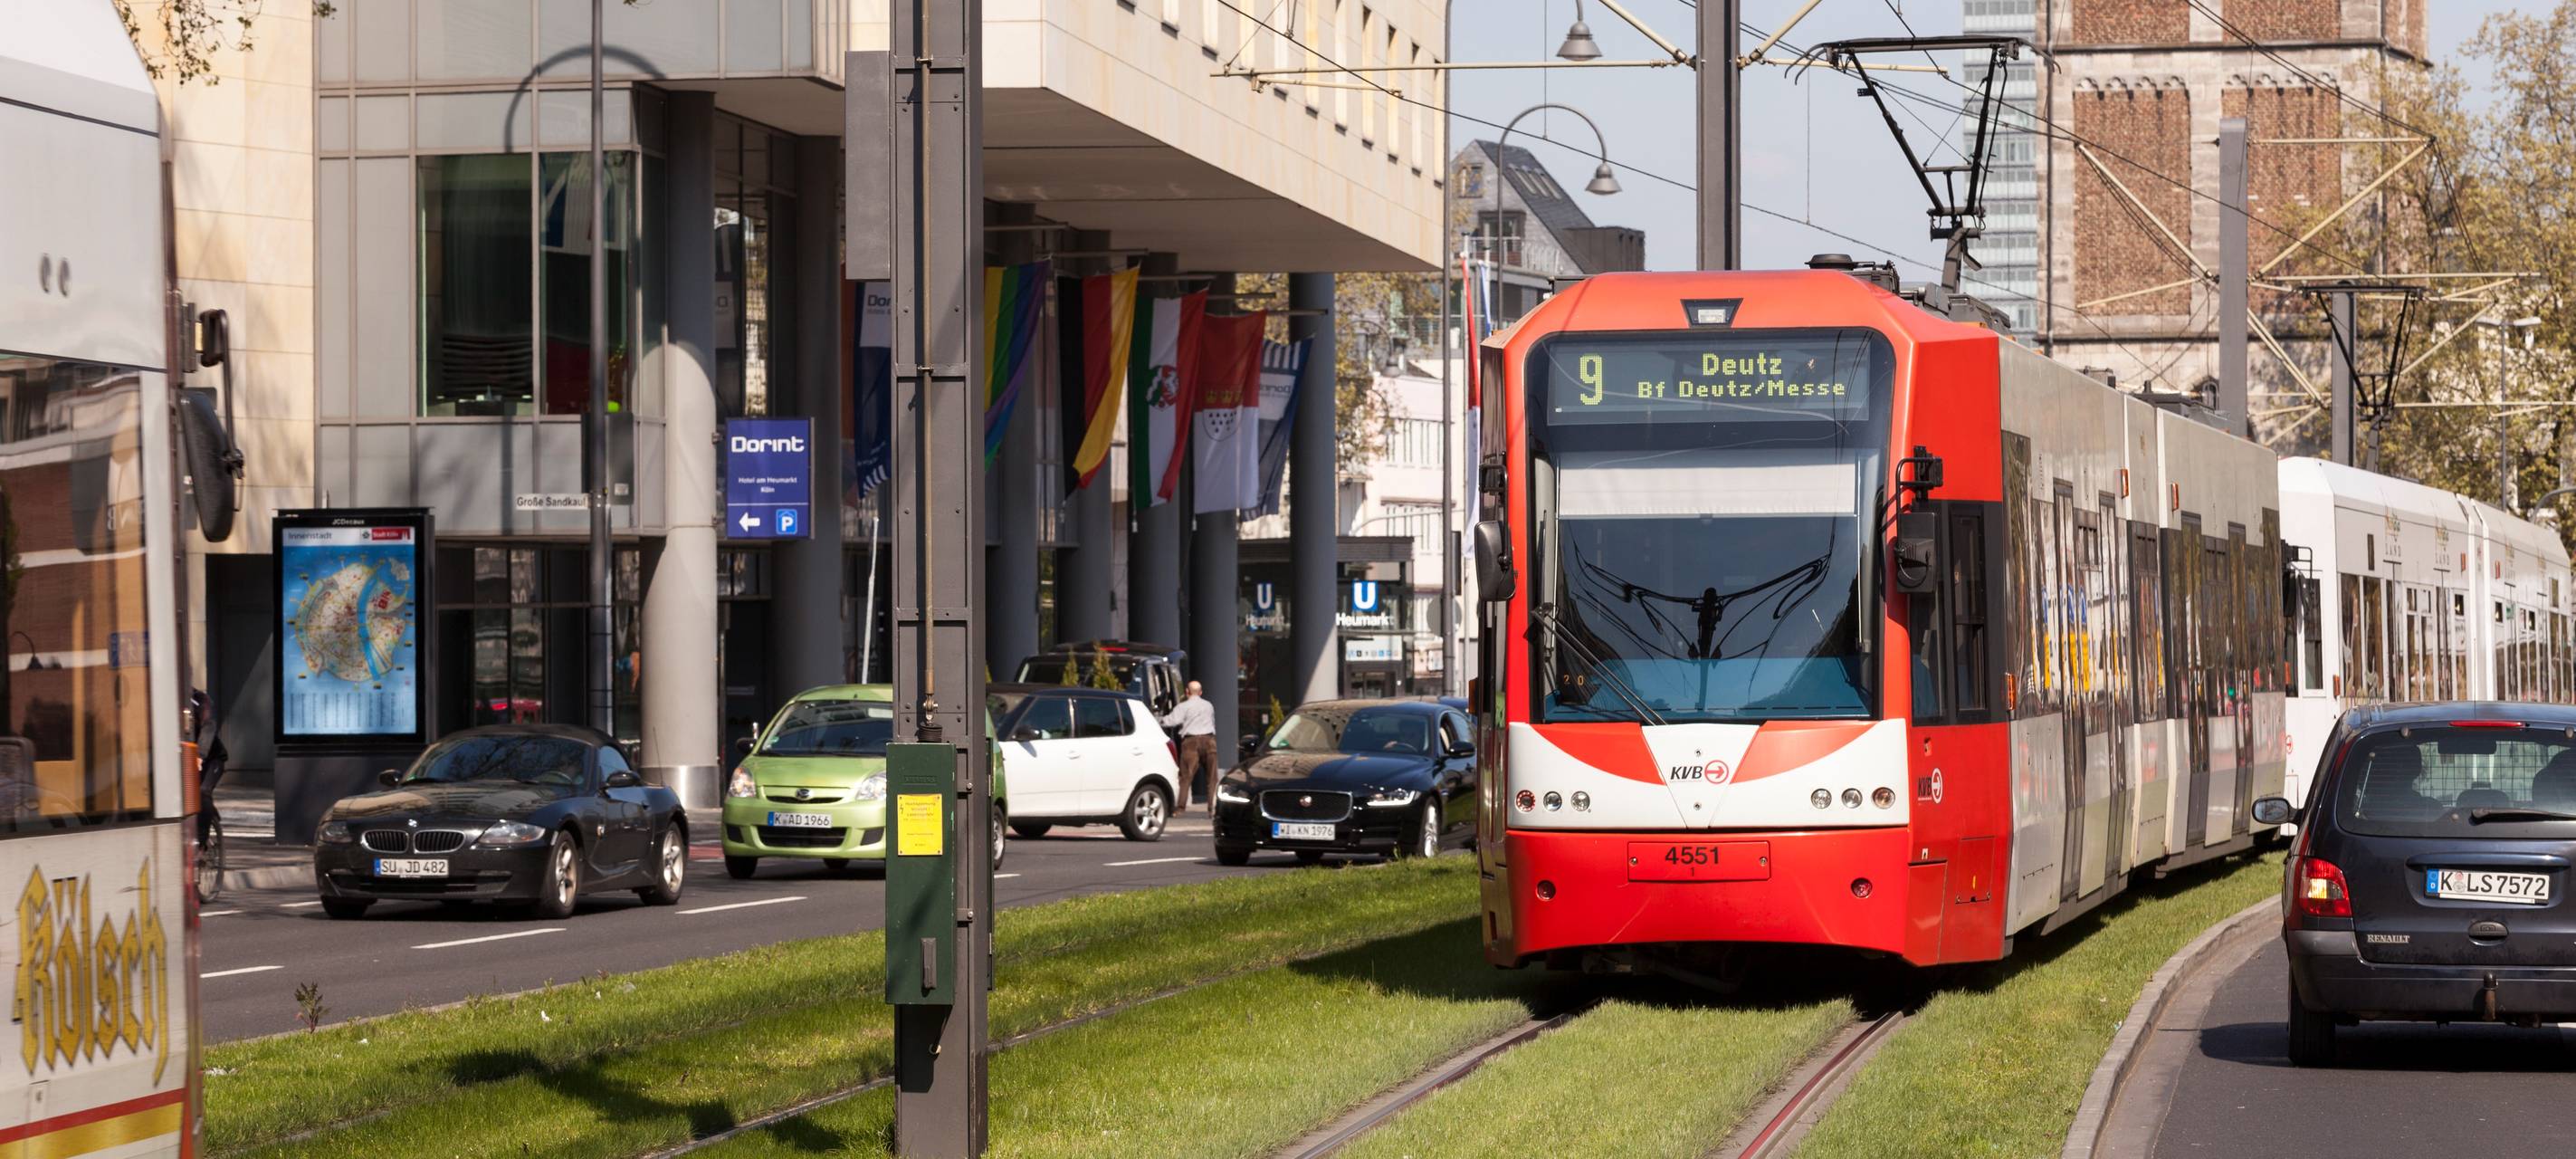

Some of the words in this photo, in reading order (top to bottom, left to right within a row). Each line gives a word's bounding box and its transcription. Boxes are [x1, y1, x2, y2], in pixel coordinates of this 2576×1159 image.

[1703, 352, 1782, 376] Deutz
[1579, 353, 1603, 406] 9
[1637, 381, 1665, 398] Bf
[1679, 379, 1846, 398] Deutz/Messe
[730, 436, 805, 453] Dorint
[767, 476, 797, 484] Heumarkt
[517, 495, 543, 507] Große
[781, 515, 794, 532] P
[1257, 582, 1272, 609] U
[1353, 581, 1376, 609] U
[1335, 611, 1395, 627] Heumarkt
[1670, 765, 1703, 781] KVB
[774, 813, 781, 825] K
[788, 814, 802, 825] AD
[804, 815, 830, 826] 1966
[1311, 826, 1333, 837] 1976
[1665, 846, 1720, 865] 4551
[381, 860, 396, 873] SU
[405, 861, 421, 874] JD
[423, 861, 446, 874] 482
[1690, 867, 1695, 877] 1
[2440, 871, 2454, 892] K
[2366, 934, 2410, 943] RENAULT
[11, 855, 169, 1088] Kölsch
